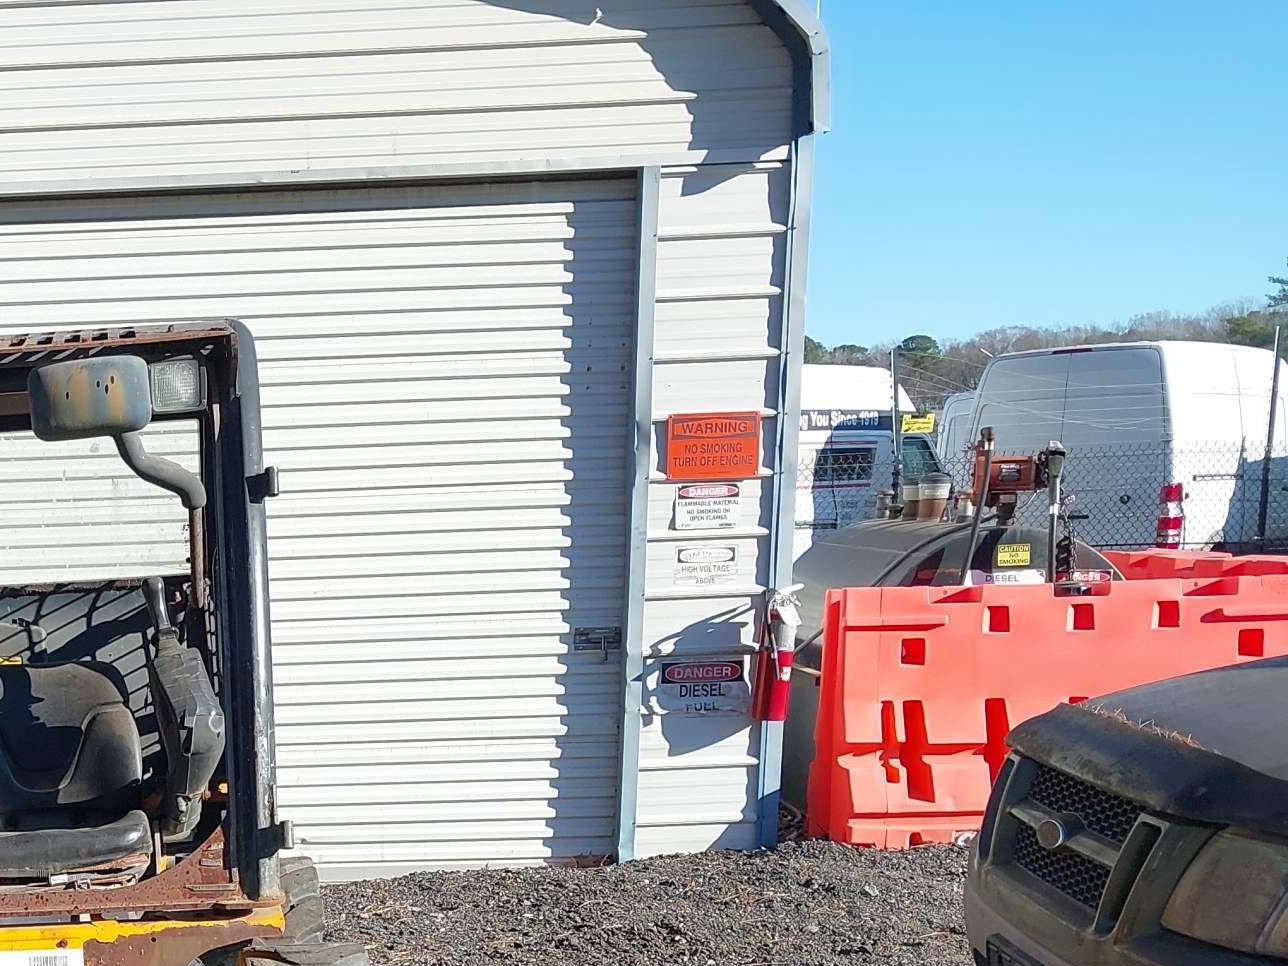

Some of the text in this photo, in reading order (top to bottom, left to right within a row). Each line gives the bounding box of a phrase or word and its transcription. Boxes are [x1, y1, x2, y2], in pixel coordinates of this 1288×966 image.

[810, 411, 829, 427] You
[830, 410, 857, 426] Since
[859, 410, 879, 426] 1919
[681, 421, 748, 434] WARNING
[684, 442, 743, 455] NO SMOKING
[673, 454, 753, 468] TURN OFF ENGINE
[688, 487, 729, 497] DANGER
[999, 544, 1030, 553] CAUTION
[681, 563, 730, 574] HIGH VOLTAGE
[673, 666, 732, 679] DANGER
[679, 683, 726, 698] DIESEL
